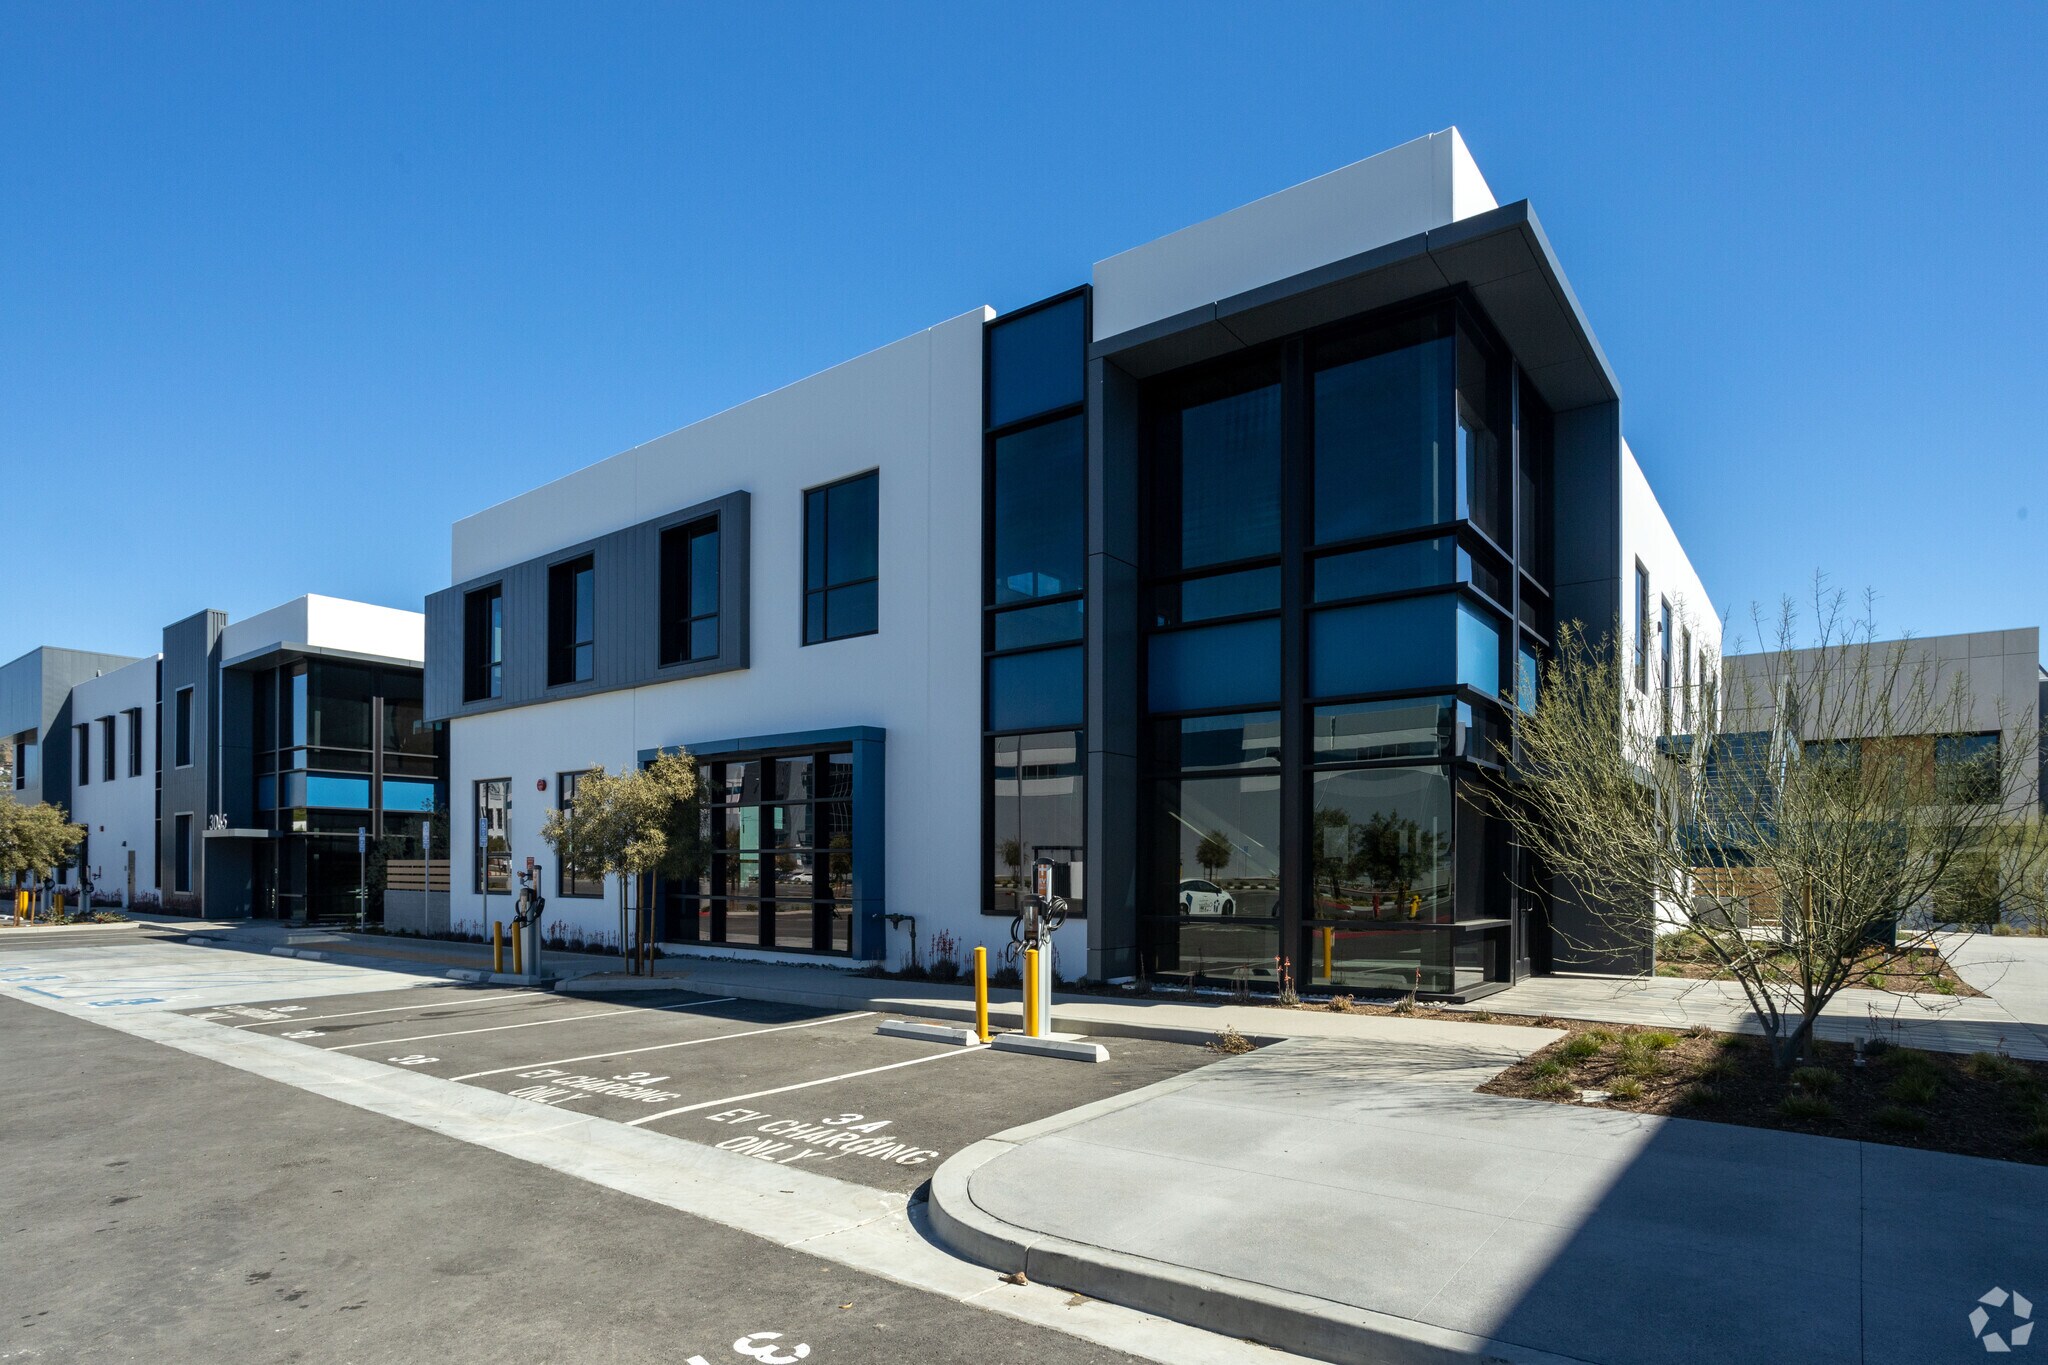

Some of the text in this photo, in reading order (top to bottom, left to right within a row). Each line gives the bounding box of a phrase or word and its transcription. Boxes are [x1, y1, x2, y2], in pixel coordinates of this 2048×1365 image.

[507, 1085, 592, 1105] ONLY
[515, 1068, 681, 1103] EV CHARGING
[705, 1108, 940, 1165] EV CHARGING
[715, 1135, 826, 1164] ONLY
